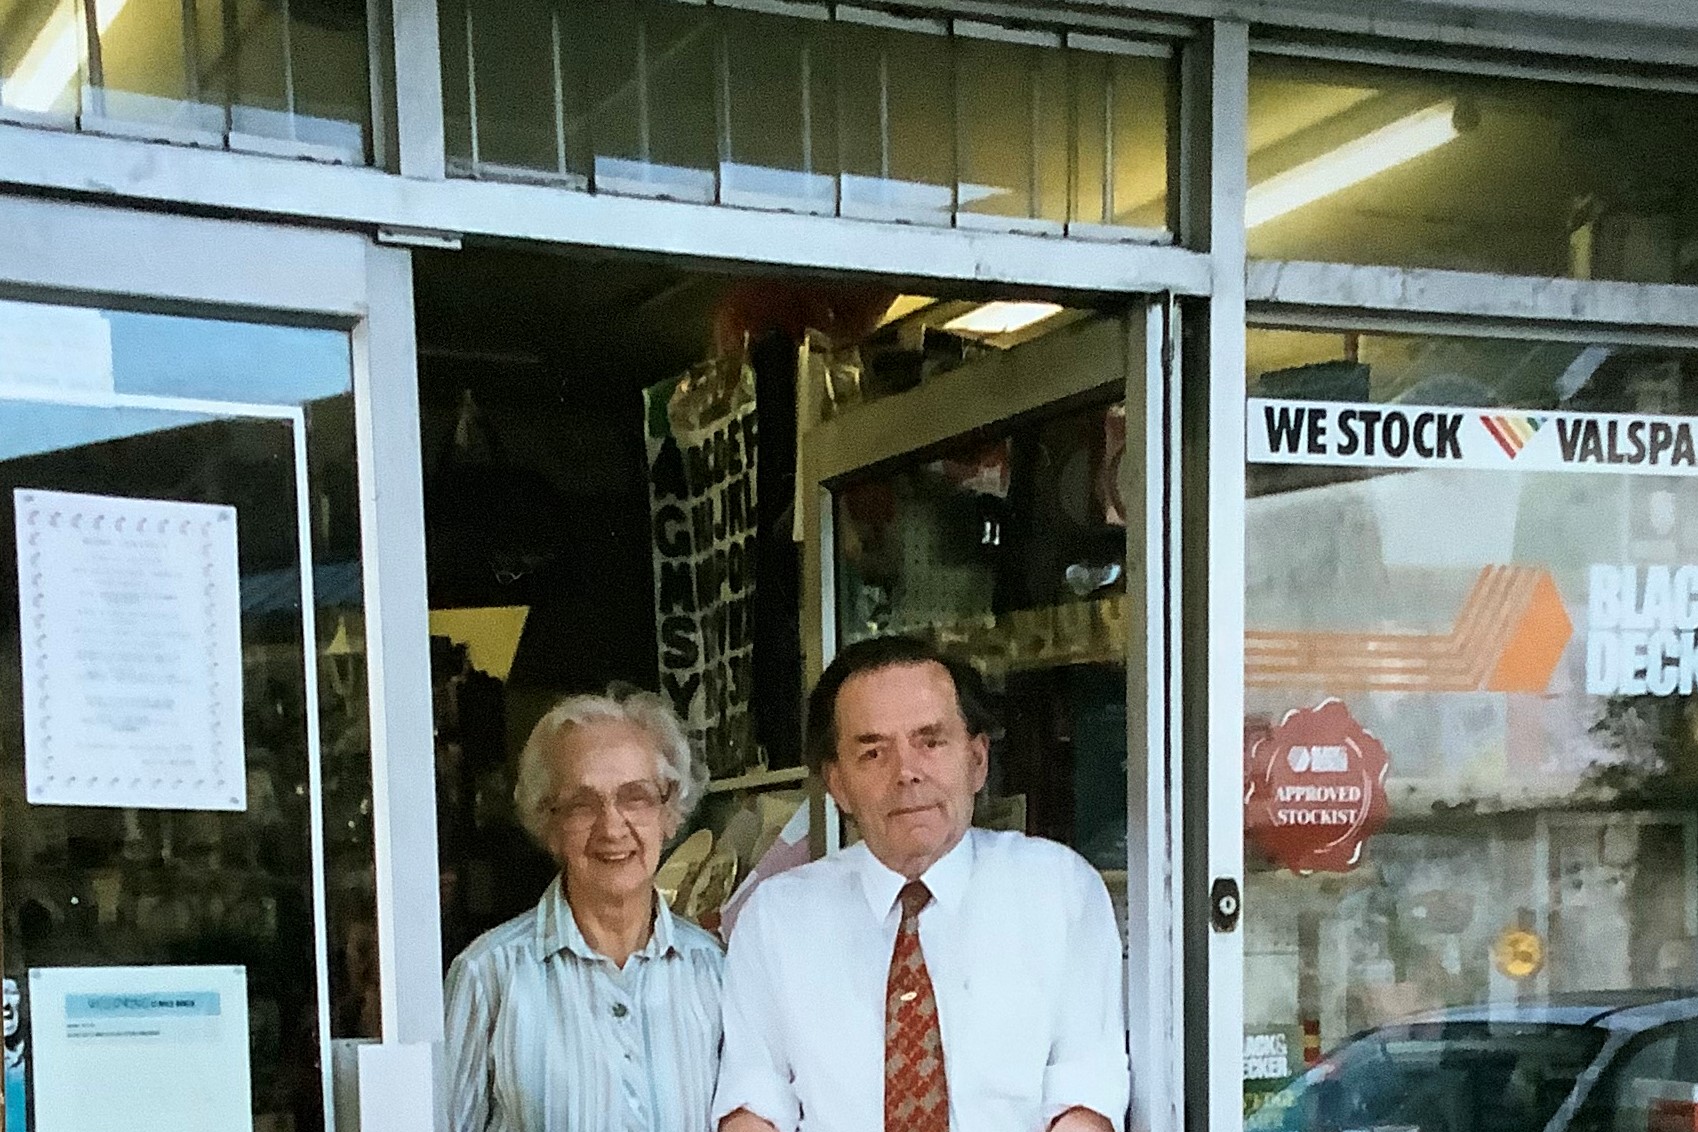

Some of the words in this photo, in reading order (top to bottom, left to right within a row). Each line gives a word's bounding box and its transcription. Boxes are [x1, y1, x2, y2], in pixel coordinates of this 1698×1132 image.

[1264, 405, 1327, 454] WE
[1337, 409, 1464, 459] STOCK
[1556, 417, 1696, 466] VALSPA
[1277, 785, 1361, 802] APPROVED
[1277, 808, 1358, 825] STOCKIST
